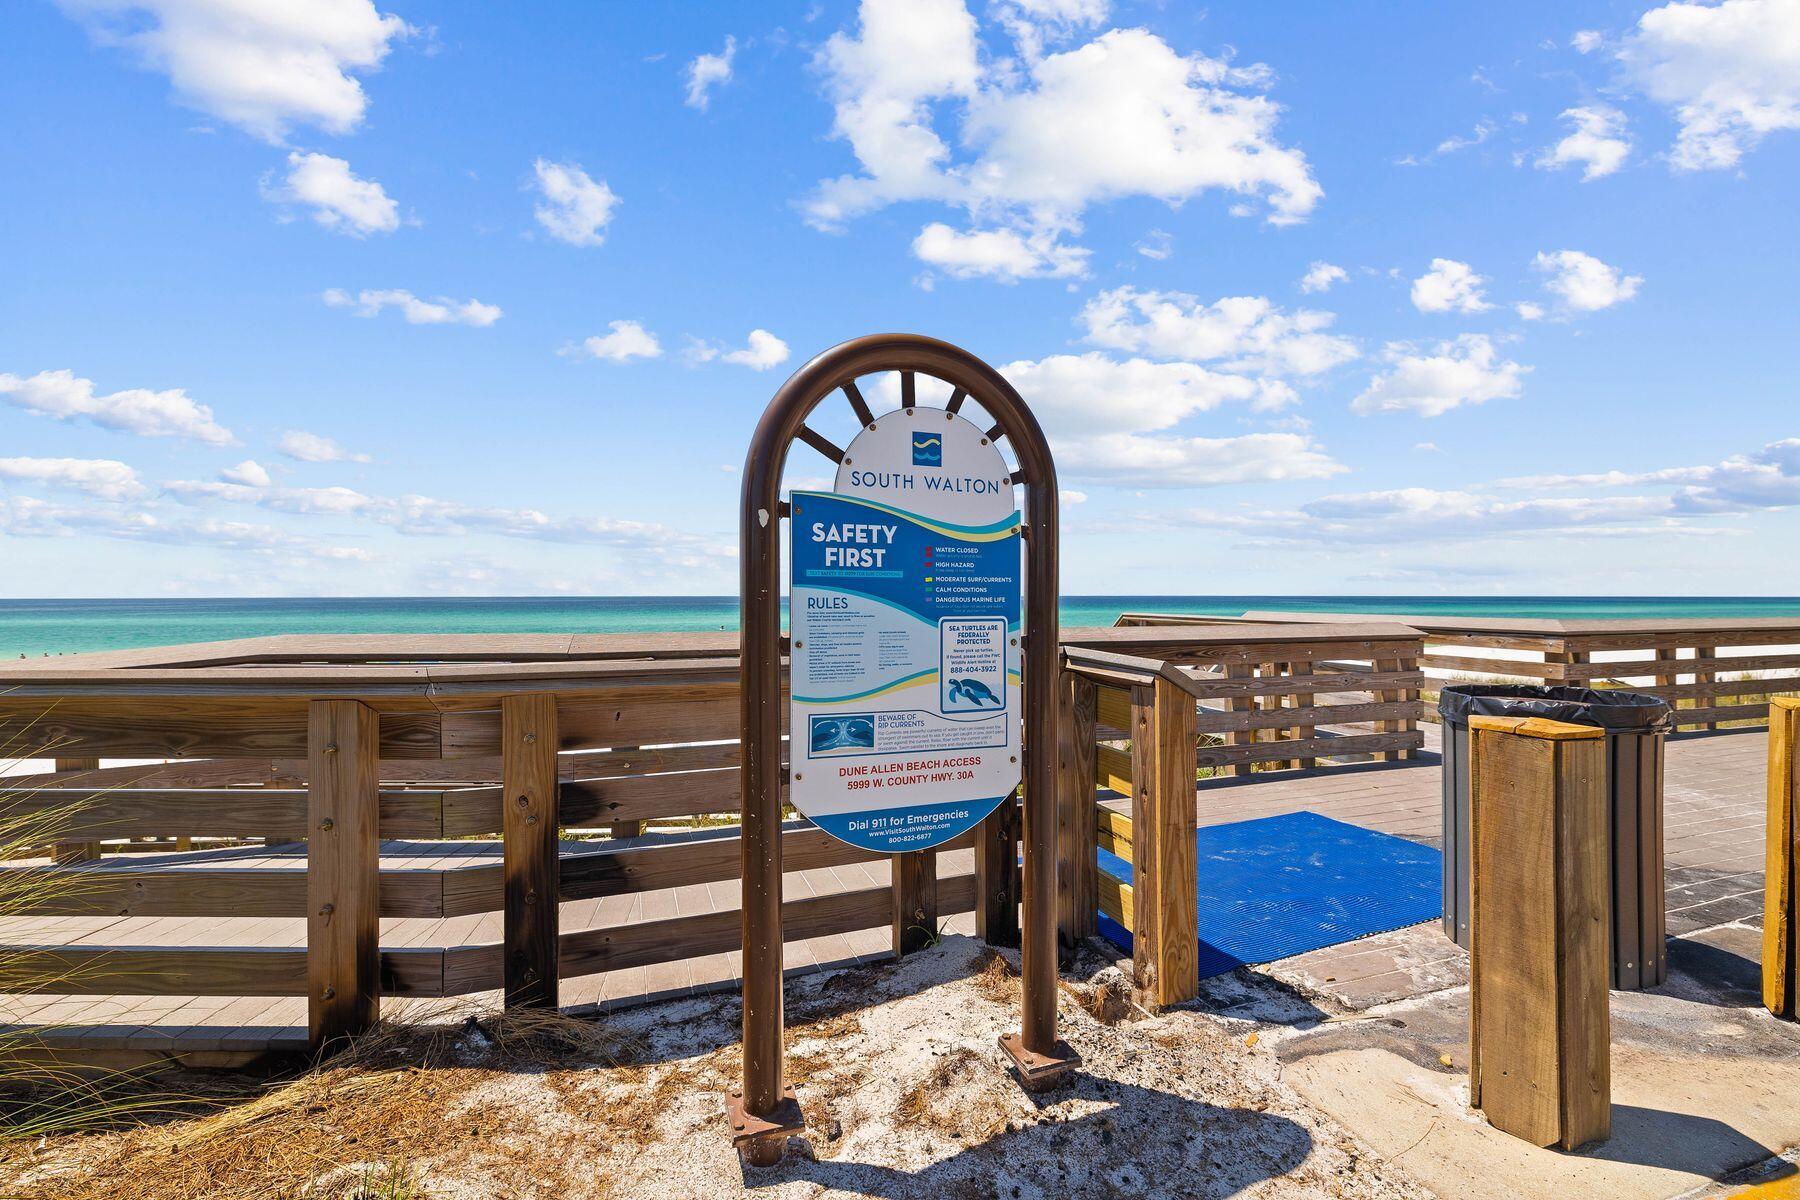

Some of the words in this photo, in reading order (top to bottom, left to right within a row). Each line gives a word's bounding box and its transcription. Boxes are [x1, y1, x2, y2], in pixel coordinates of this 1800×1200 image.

[851, 470, 914, 490] SOUTH
[924, 475, 999, 495] WALTON
[811, 522, 898, 544] SAFETY
[825, 548, 886, 568] FIRST
[808, 597, 848, 609] RULES
[950, 665, 997, 674] 888-404-3922
[889, 720, 925, 728] CURRENTS
[839, 765, 868, 777] DUNE
[870, 763, 904, 774] ALLEN
[906, 759, 941, 771] BEACH
[942, 756, 982, 768] ACCESS
[847, 779, 870, 790] 5999
[872, 778, 884, 788] W.
[887, 774, 929, 787] COUNTY
[931, 772, 955, 782] HWY.
[957, 770, 975, 780] 30A
[848, 819, 869, 831] Dial
[871, 817, 887, 828] 911
[889, 816, 905, 827] for
[907, 810, 969, 825] Emergencies
[868, 822, 951, 838] www.VisitSouthWalton.com
[888, 833, 932, 844] 800-822-6877
